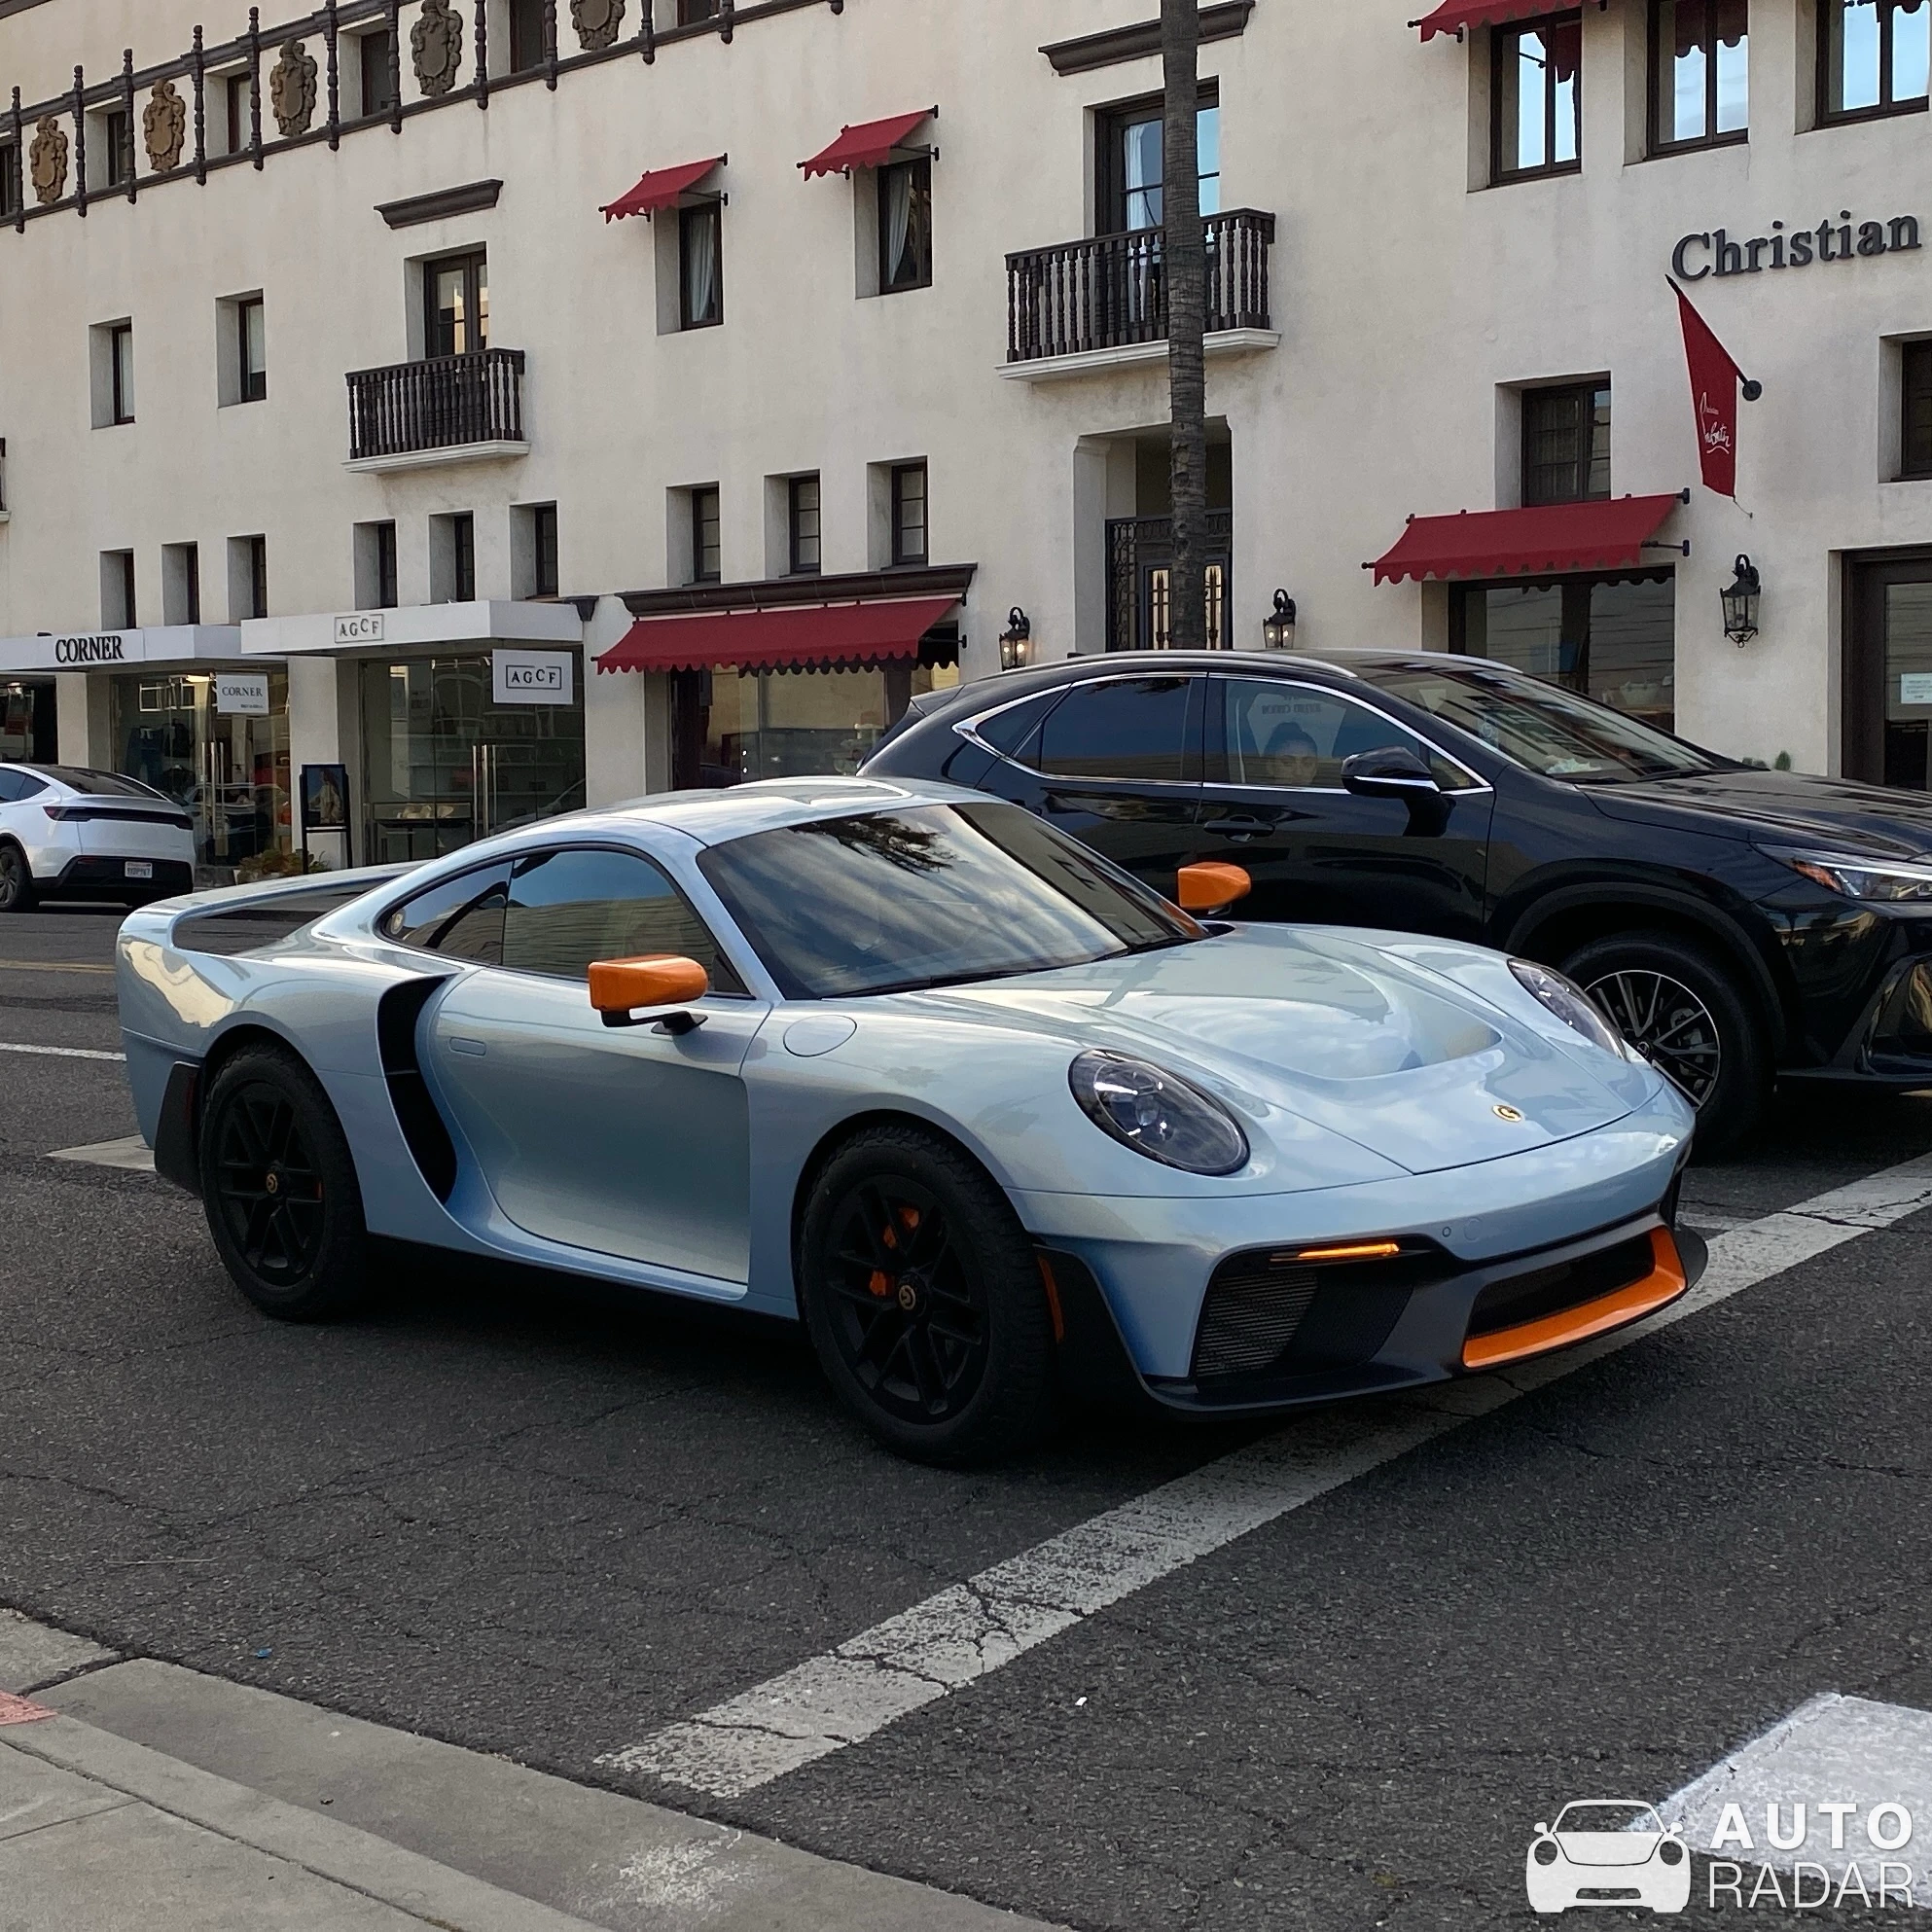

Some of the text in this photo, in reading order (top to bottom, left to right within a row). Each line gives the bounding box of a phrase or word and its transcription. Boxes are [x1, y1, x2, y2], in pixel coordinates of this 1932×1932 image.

[1671, 209, 1922, 282] Christian
[339, 617, 380, 637] AGCF
[54, 635, 125, 663] CORNER
[511, 668, 556, 685] AGCF
[222, 686, 264, 698] CORNER
